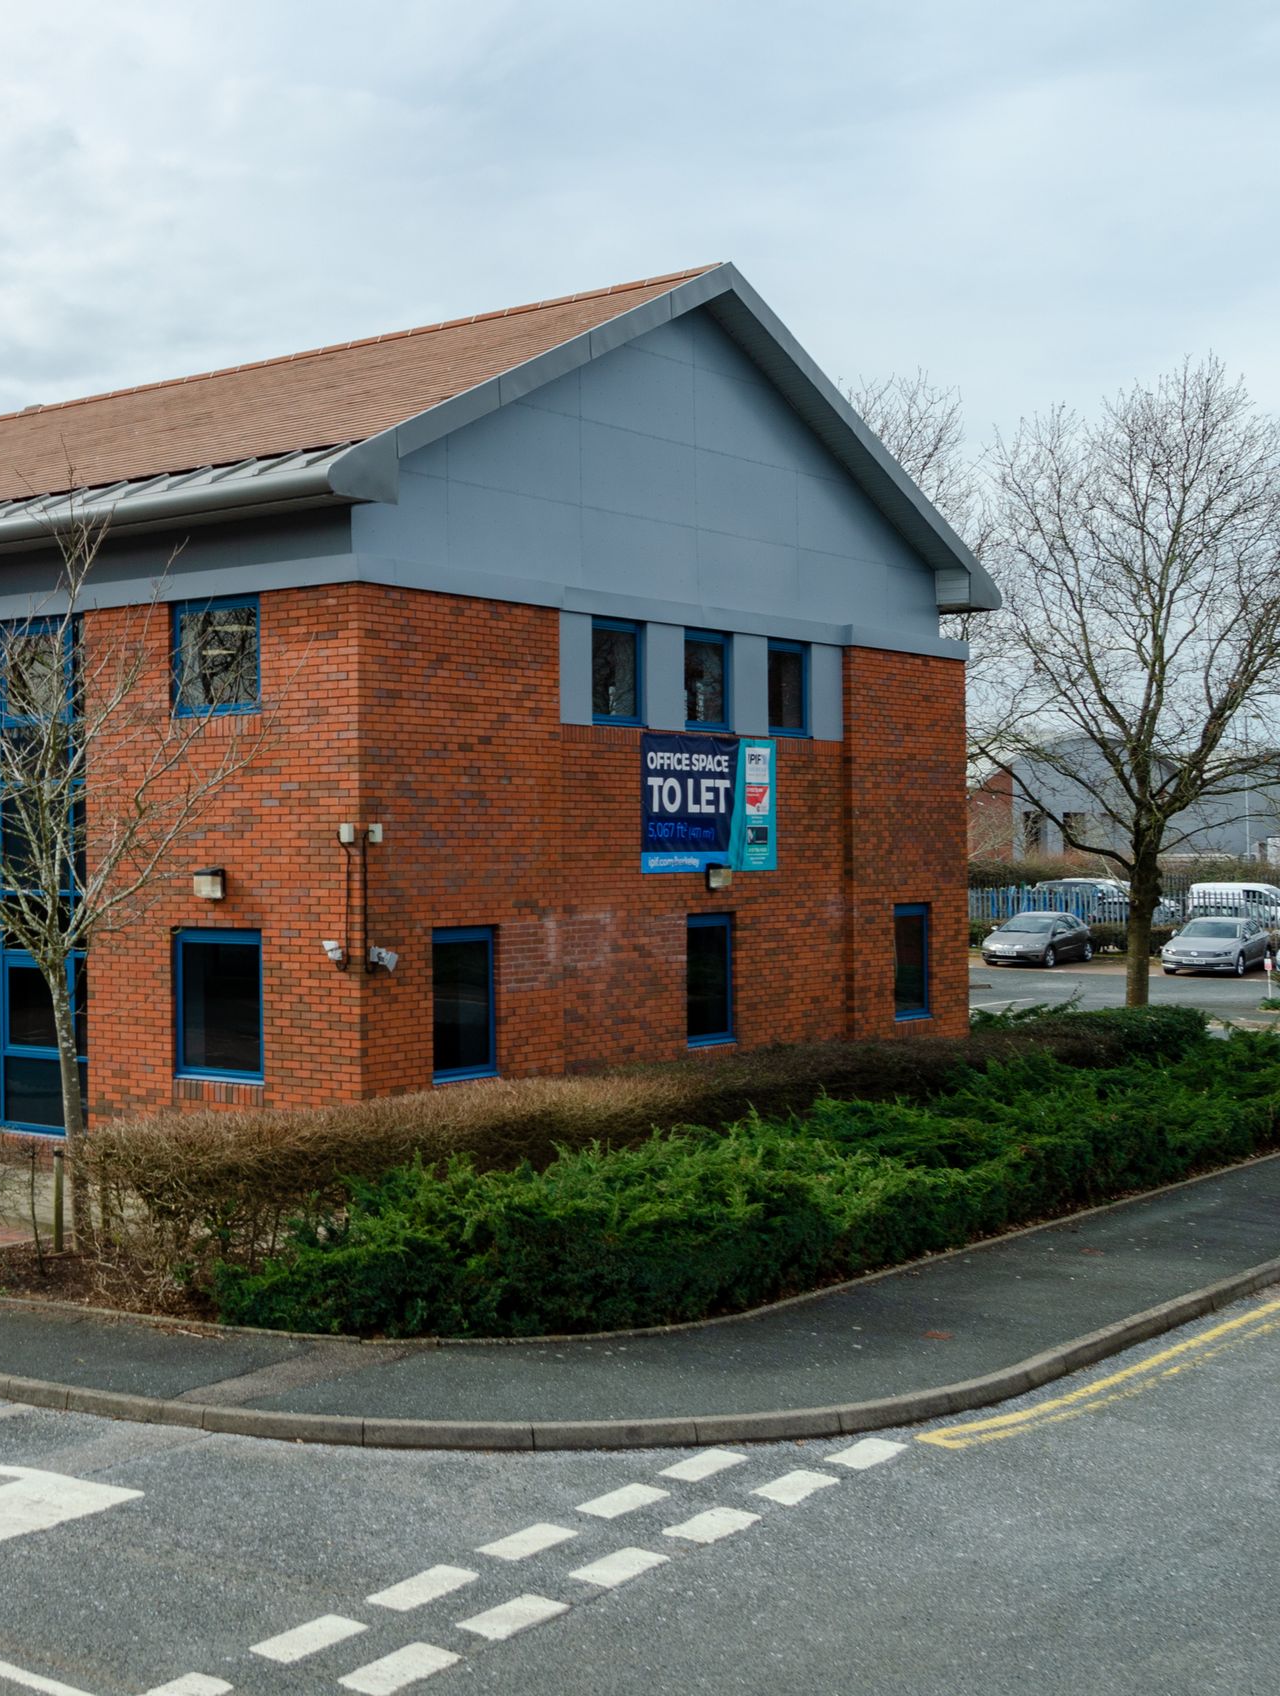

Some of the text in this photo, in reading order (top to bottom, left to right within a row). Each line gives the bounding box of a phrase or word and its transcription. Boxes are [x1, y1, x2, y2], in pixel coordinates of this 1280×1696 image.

[647, 752, 690, 770] OFFICE
[691, 754, 729, 772] SPACE
[647, 777, 731, 813] TO LET
[648, 822, 675, 840] 5,067
